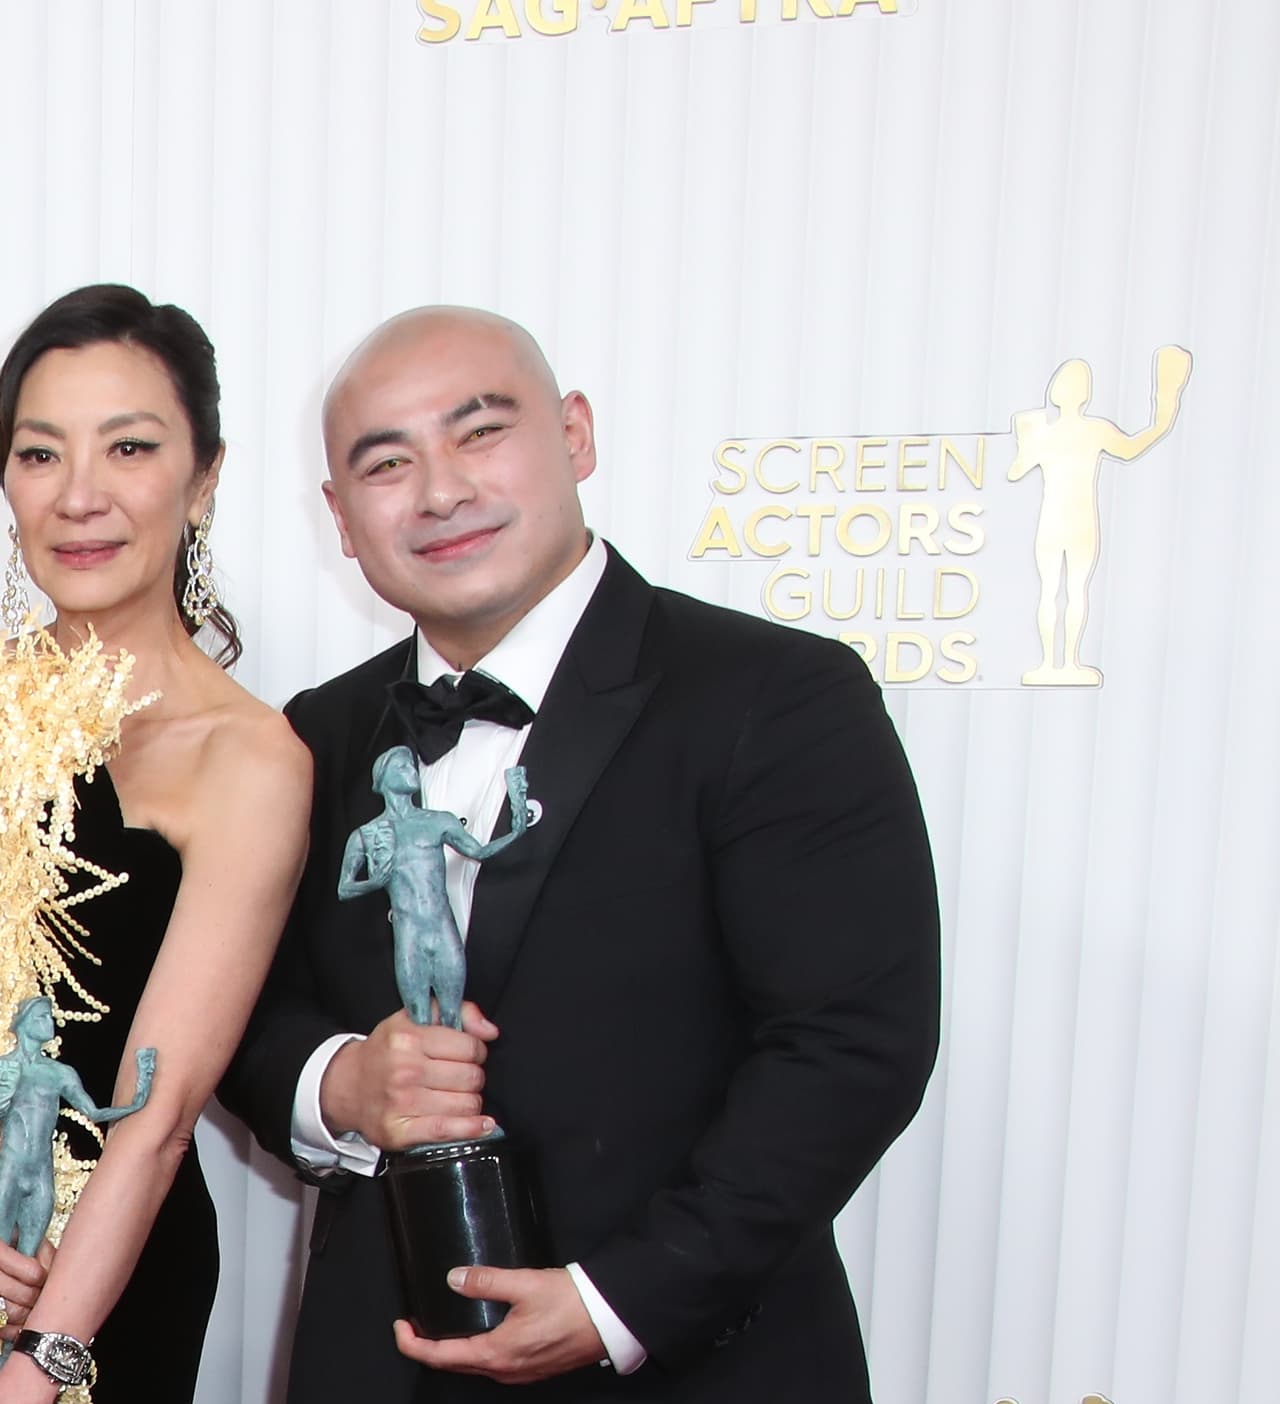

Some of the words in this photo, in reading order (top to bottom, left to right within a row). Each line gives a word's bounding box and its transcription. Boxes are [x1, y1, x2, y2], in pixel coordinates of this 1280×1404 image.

[712, 437, 985, 494] SCREEN
[690, 503, 985, 557] ACTORS
[763, 567, 980, 621] GUILD
